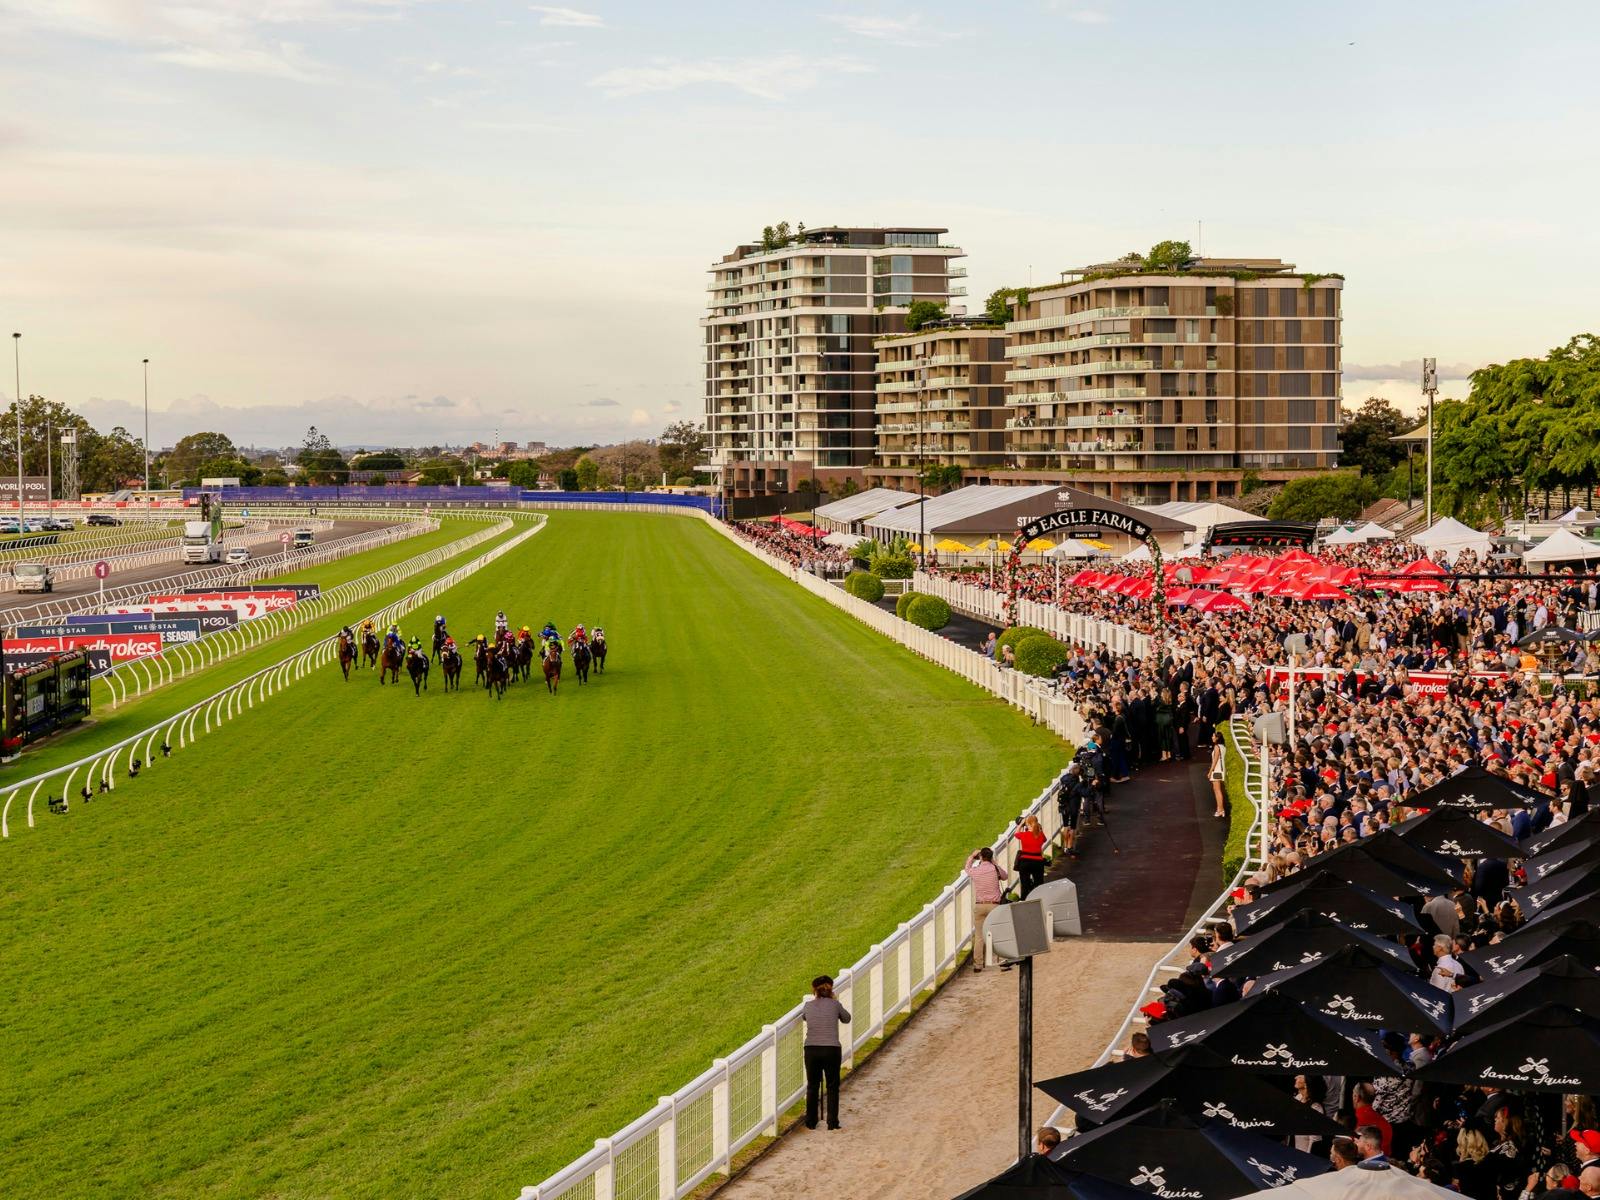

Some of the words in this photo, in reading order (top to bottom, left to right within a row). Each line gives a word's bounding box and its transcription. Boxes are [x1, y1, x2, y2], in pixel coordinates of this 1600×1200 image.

[1038, 510, 1087, 532] EAGLE
[1092, 510, 1133, 532] FARM
[282, 534, 288, 542] 2
[98, 564, 105, 576] 1
[296, 589, 317, 597] TAR
[202, 616, 231, 626] POOL
[166, 630, 196, 642] SEASON
[68, 638, 158, 657] Ldbrokes
[1341, 1008, 1384, 1020] Squire
[1231, 1054, 1278, 1066] James
[1281, 1056, 1328, 1068] Squire
[1480, 1066, 1529, 1081] James
[1532, 1073, 1582, 1086] Squire
[1229, 1118, 1276, 1129] Squire
[1152, 1185, 1203, 1199] Squire
